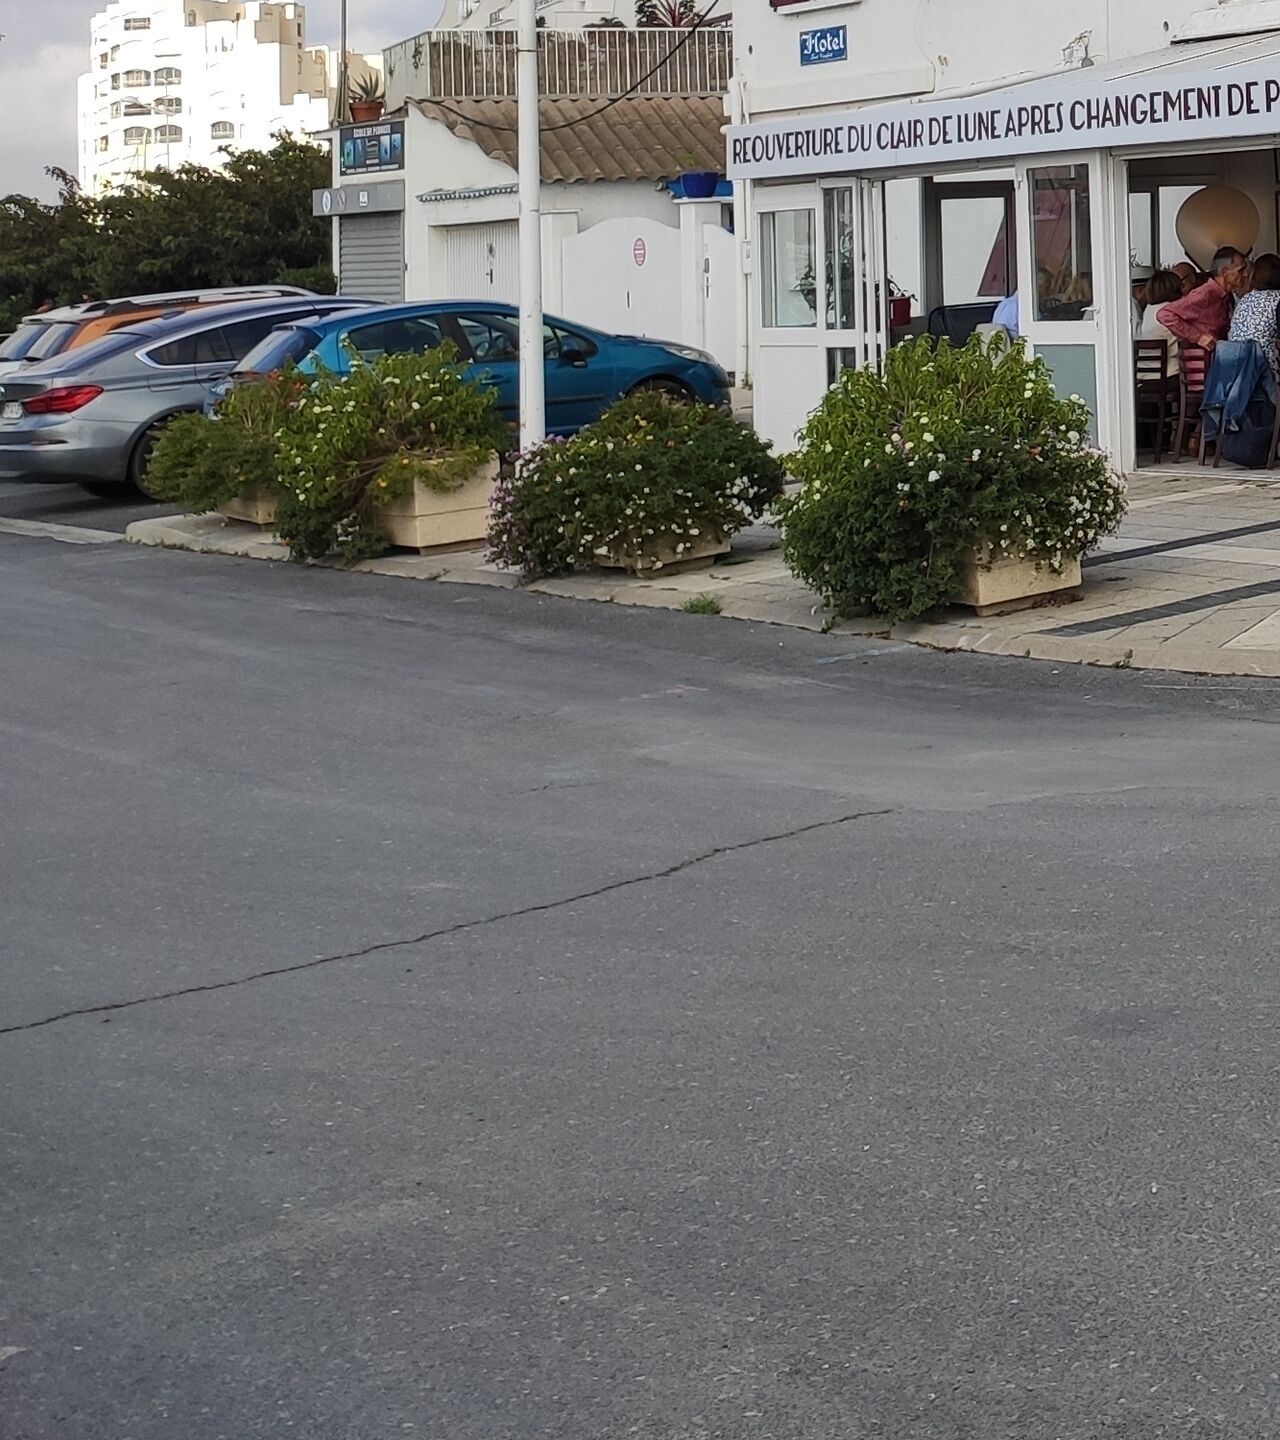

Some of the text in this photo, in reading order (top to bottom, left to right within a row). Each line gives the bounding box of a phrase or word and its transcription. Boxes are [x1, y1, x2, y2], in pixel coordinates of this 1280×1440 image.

[801, 29, 845, 54] Hotel
[732, 126, 844, 165] REOUVERTURE
[848, 123, 872, 153] DU
[876, 118, 925, 151] CLAIR
[928, 115, 953, 146] DE
[956, 109, 1001, 143] LUNE
[1004, 101, 1064, 138] APRES
[1069, 84, 1222, 131] CHANGEMENT
[1226, 80, 1261, 117] DE
